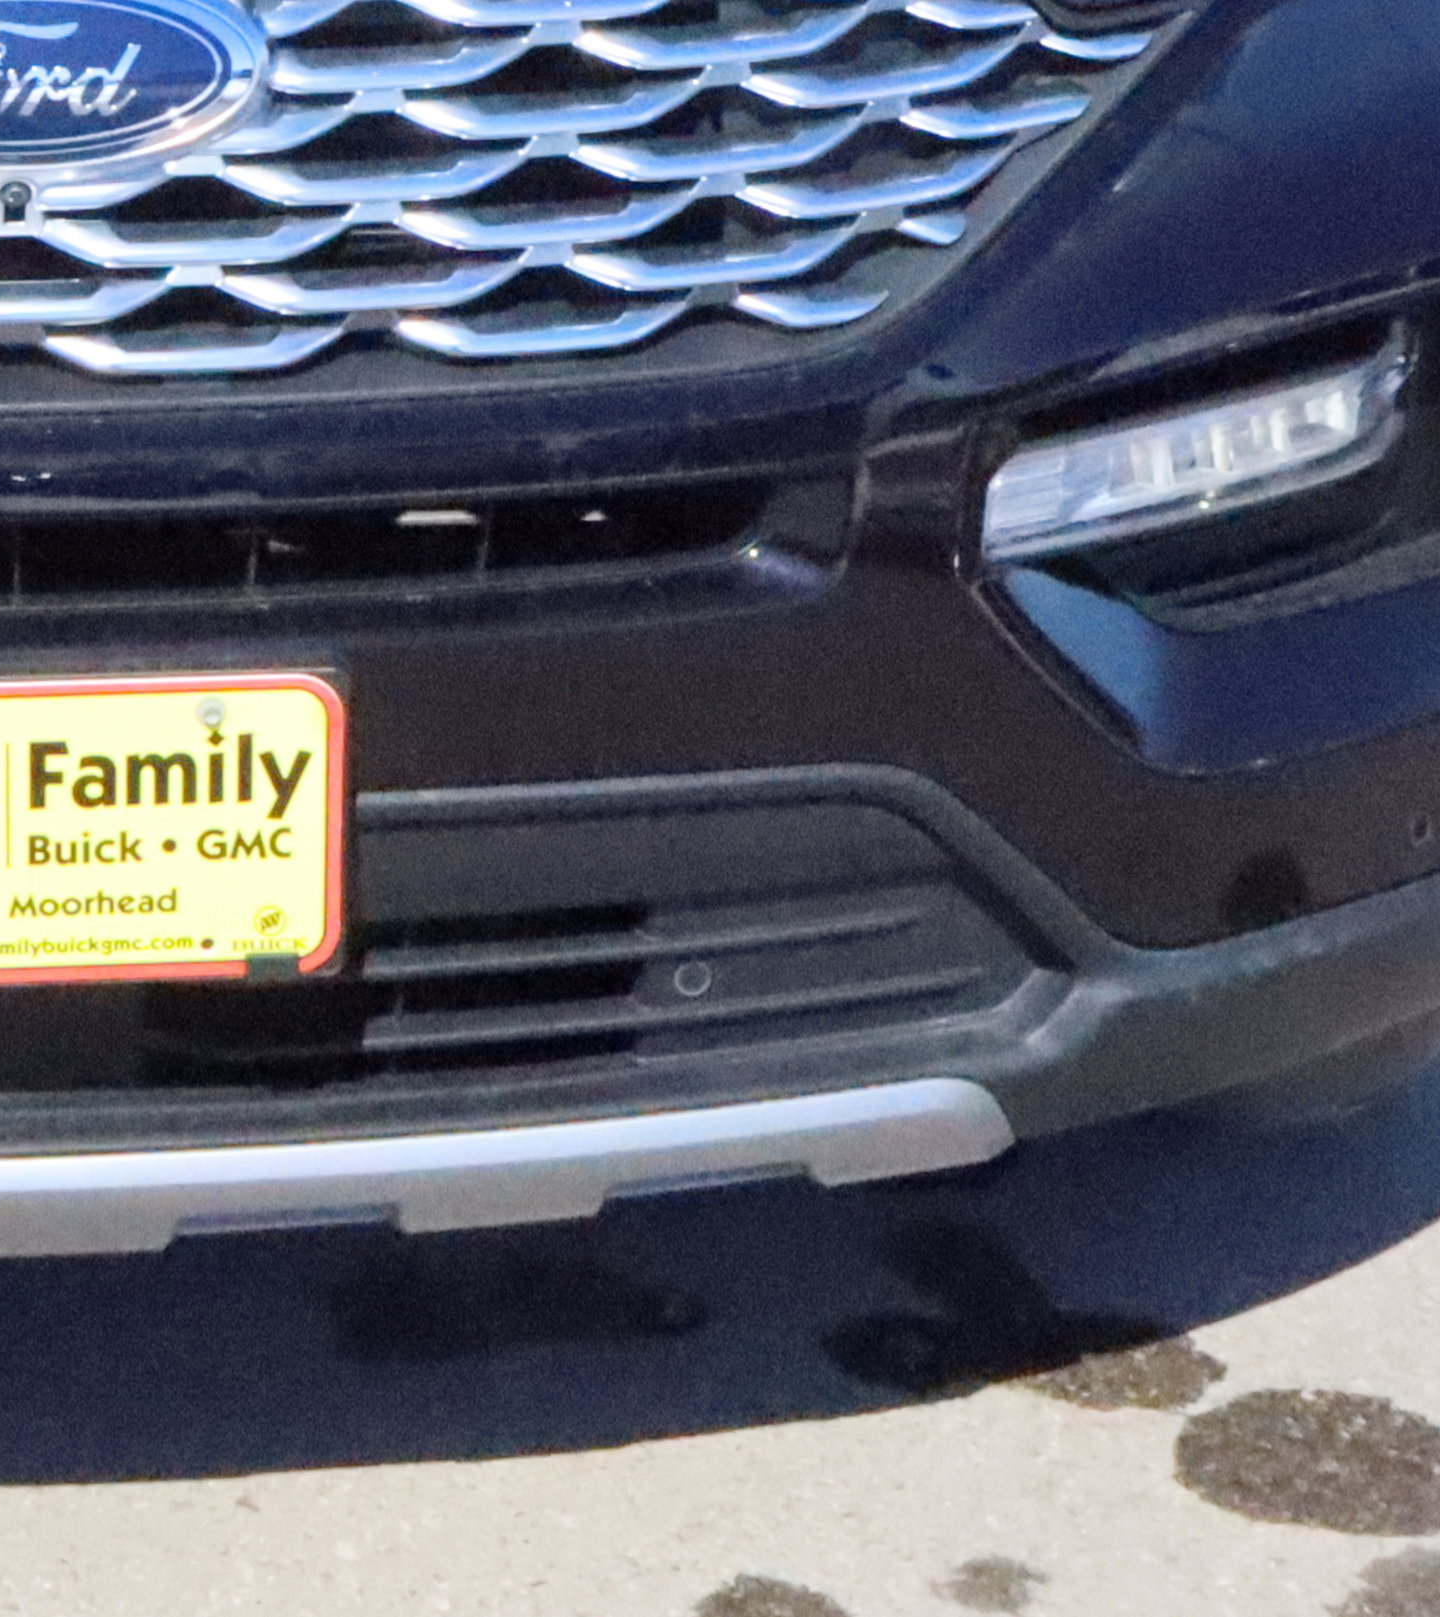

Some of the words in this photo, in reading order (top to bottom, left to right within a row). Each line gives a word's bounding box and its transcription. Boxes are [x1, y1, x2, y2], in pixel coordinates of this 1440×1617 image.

[28, 730, 313, 820] Family
[28, 830, 143, 866] Buick
[196, 827, 293, 860] GMC
[8, 887, 178, 918] Moorhead
[231, 936, 308, 952] BUICK
